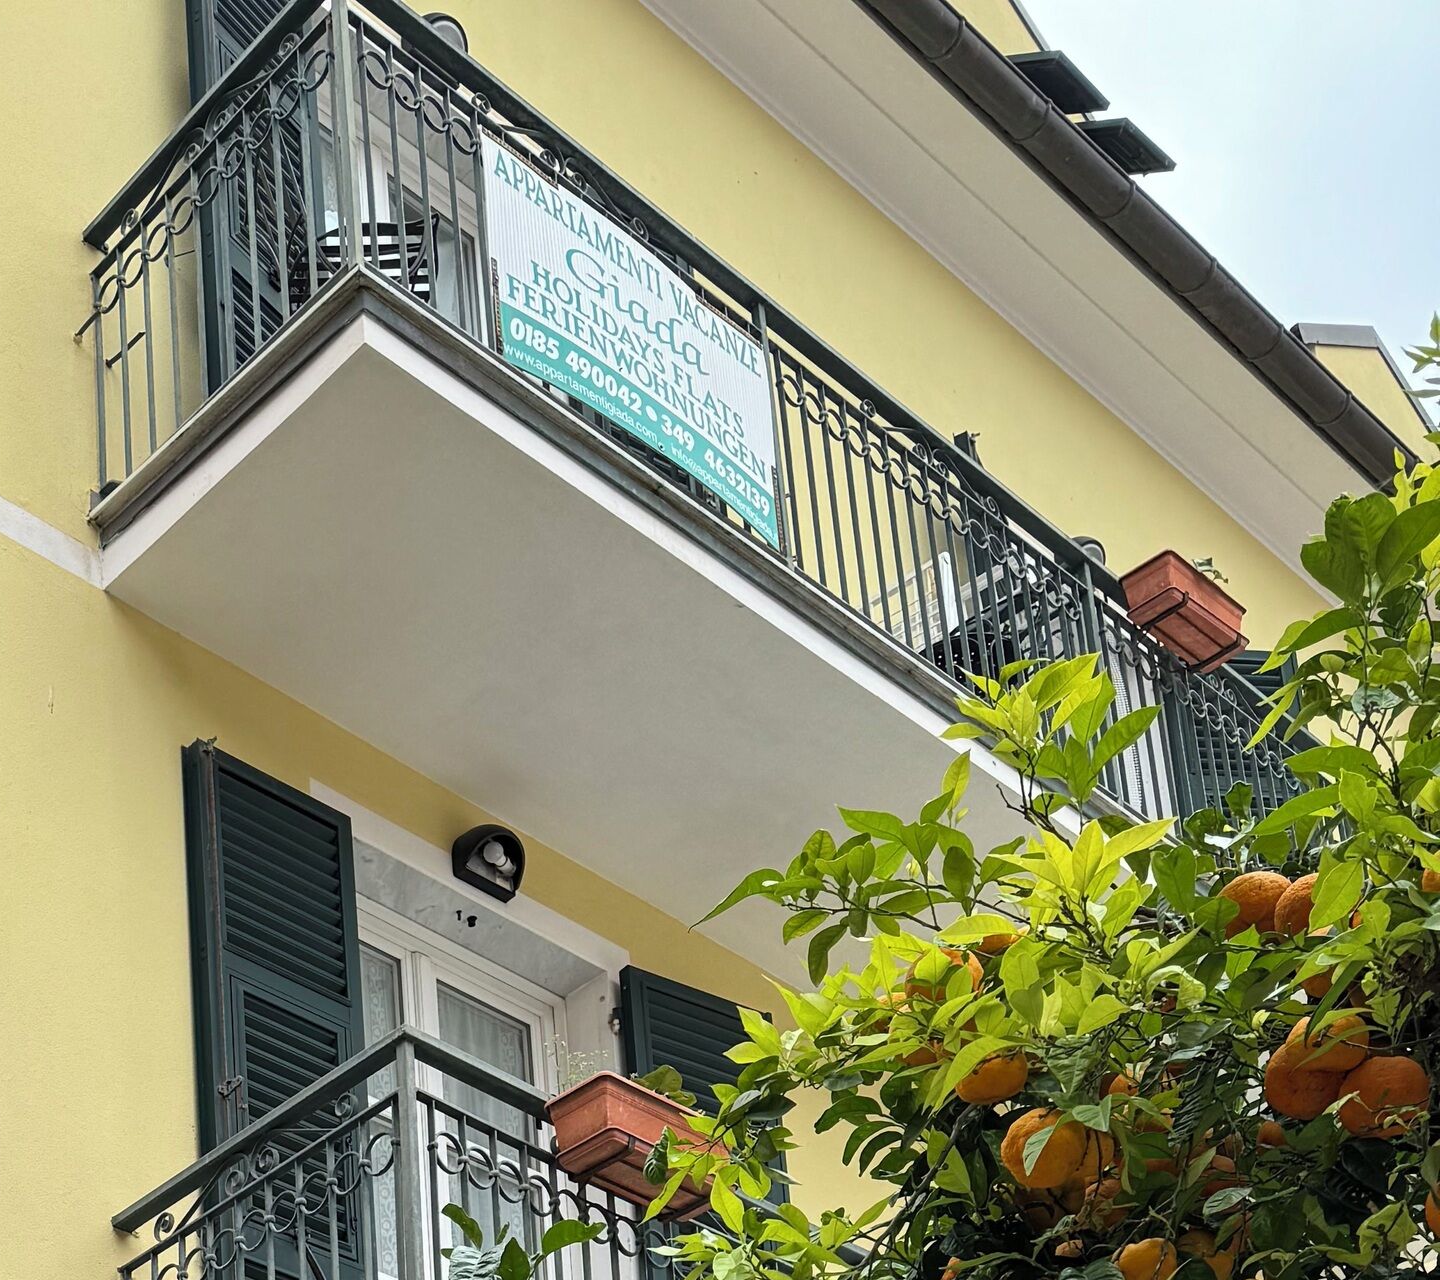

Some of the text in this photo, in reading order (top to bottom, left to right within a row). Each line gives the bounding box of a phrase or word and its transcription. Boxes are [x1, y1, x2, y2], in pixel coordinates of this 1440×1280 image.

[494, 148, 763, 378] APPARTAMENTI VACANZE
[530, 259, 745, 438] HOLIDAYS FLATS
[565, 246, 711, 377] Giada
[506, 272, 768, 484] FERIENWOHNUNGEN
[510, 317, 771, 518] 0185 490042 349 4632139
